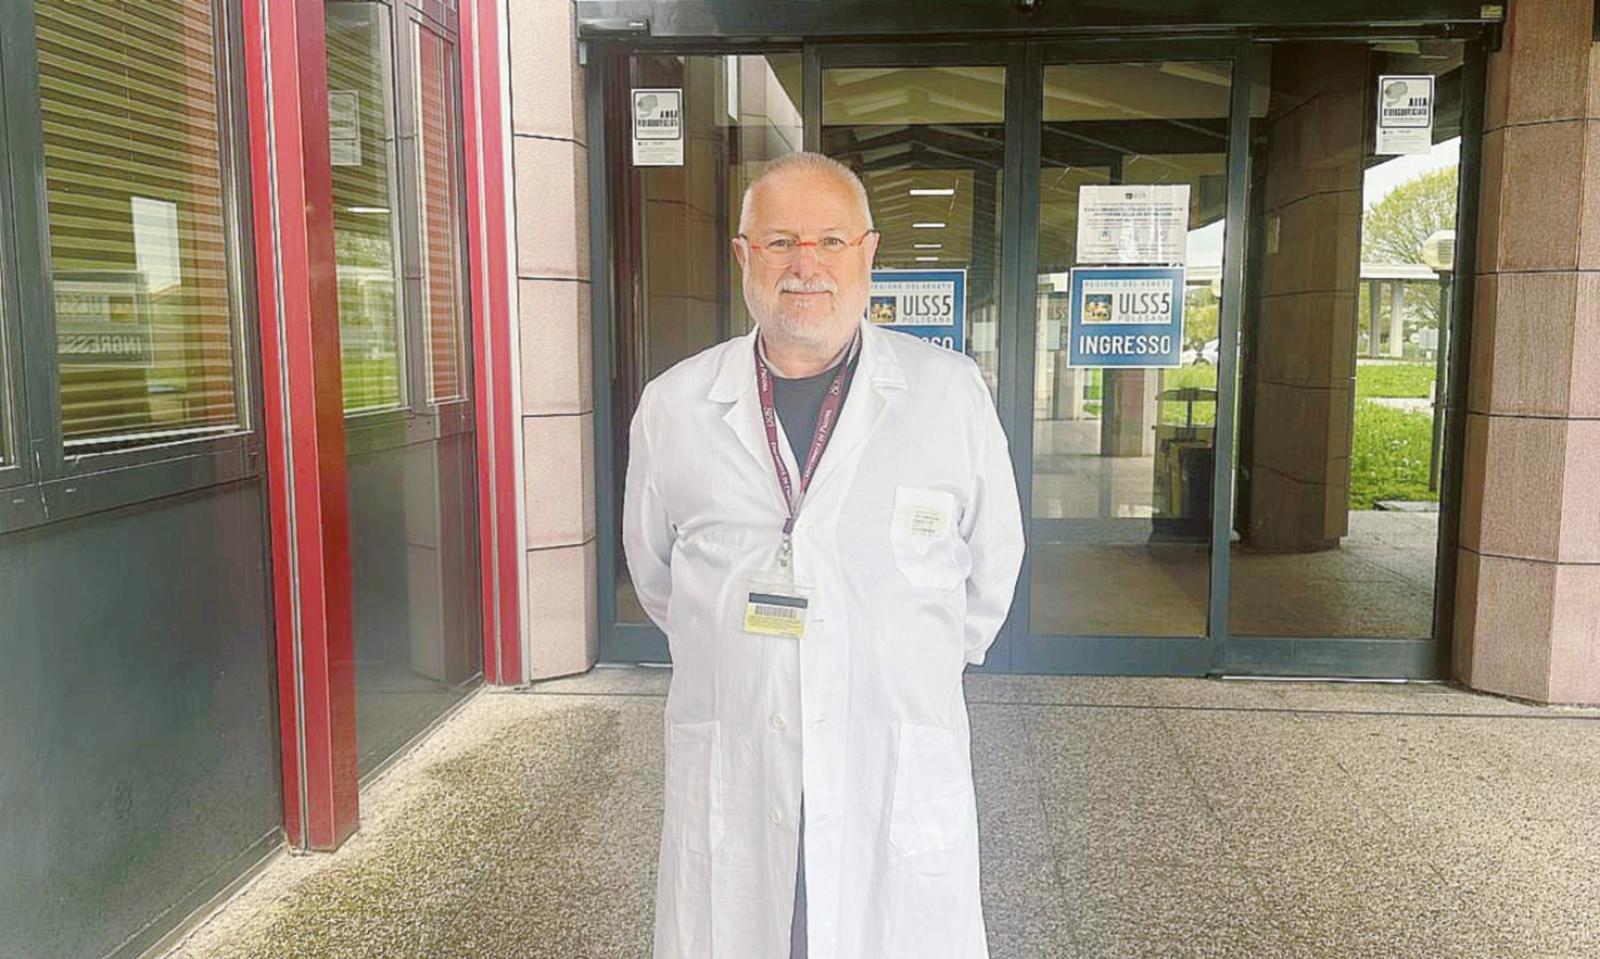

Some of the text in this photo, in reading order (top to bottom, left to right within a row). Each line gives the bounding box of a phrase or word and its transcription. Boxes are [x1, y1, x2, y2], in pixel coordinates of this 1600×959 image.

[903, 295, 952, 317] ULSS5
[1119, 293, 1170, 315] ULSS5
[1079, 335, 1171, 354] INGRESSO
